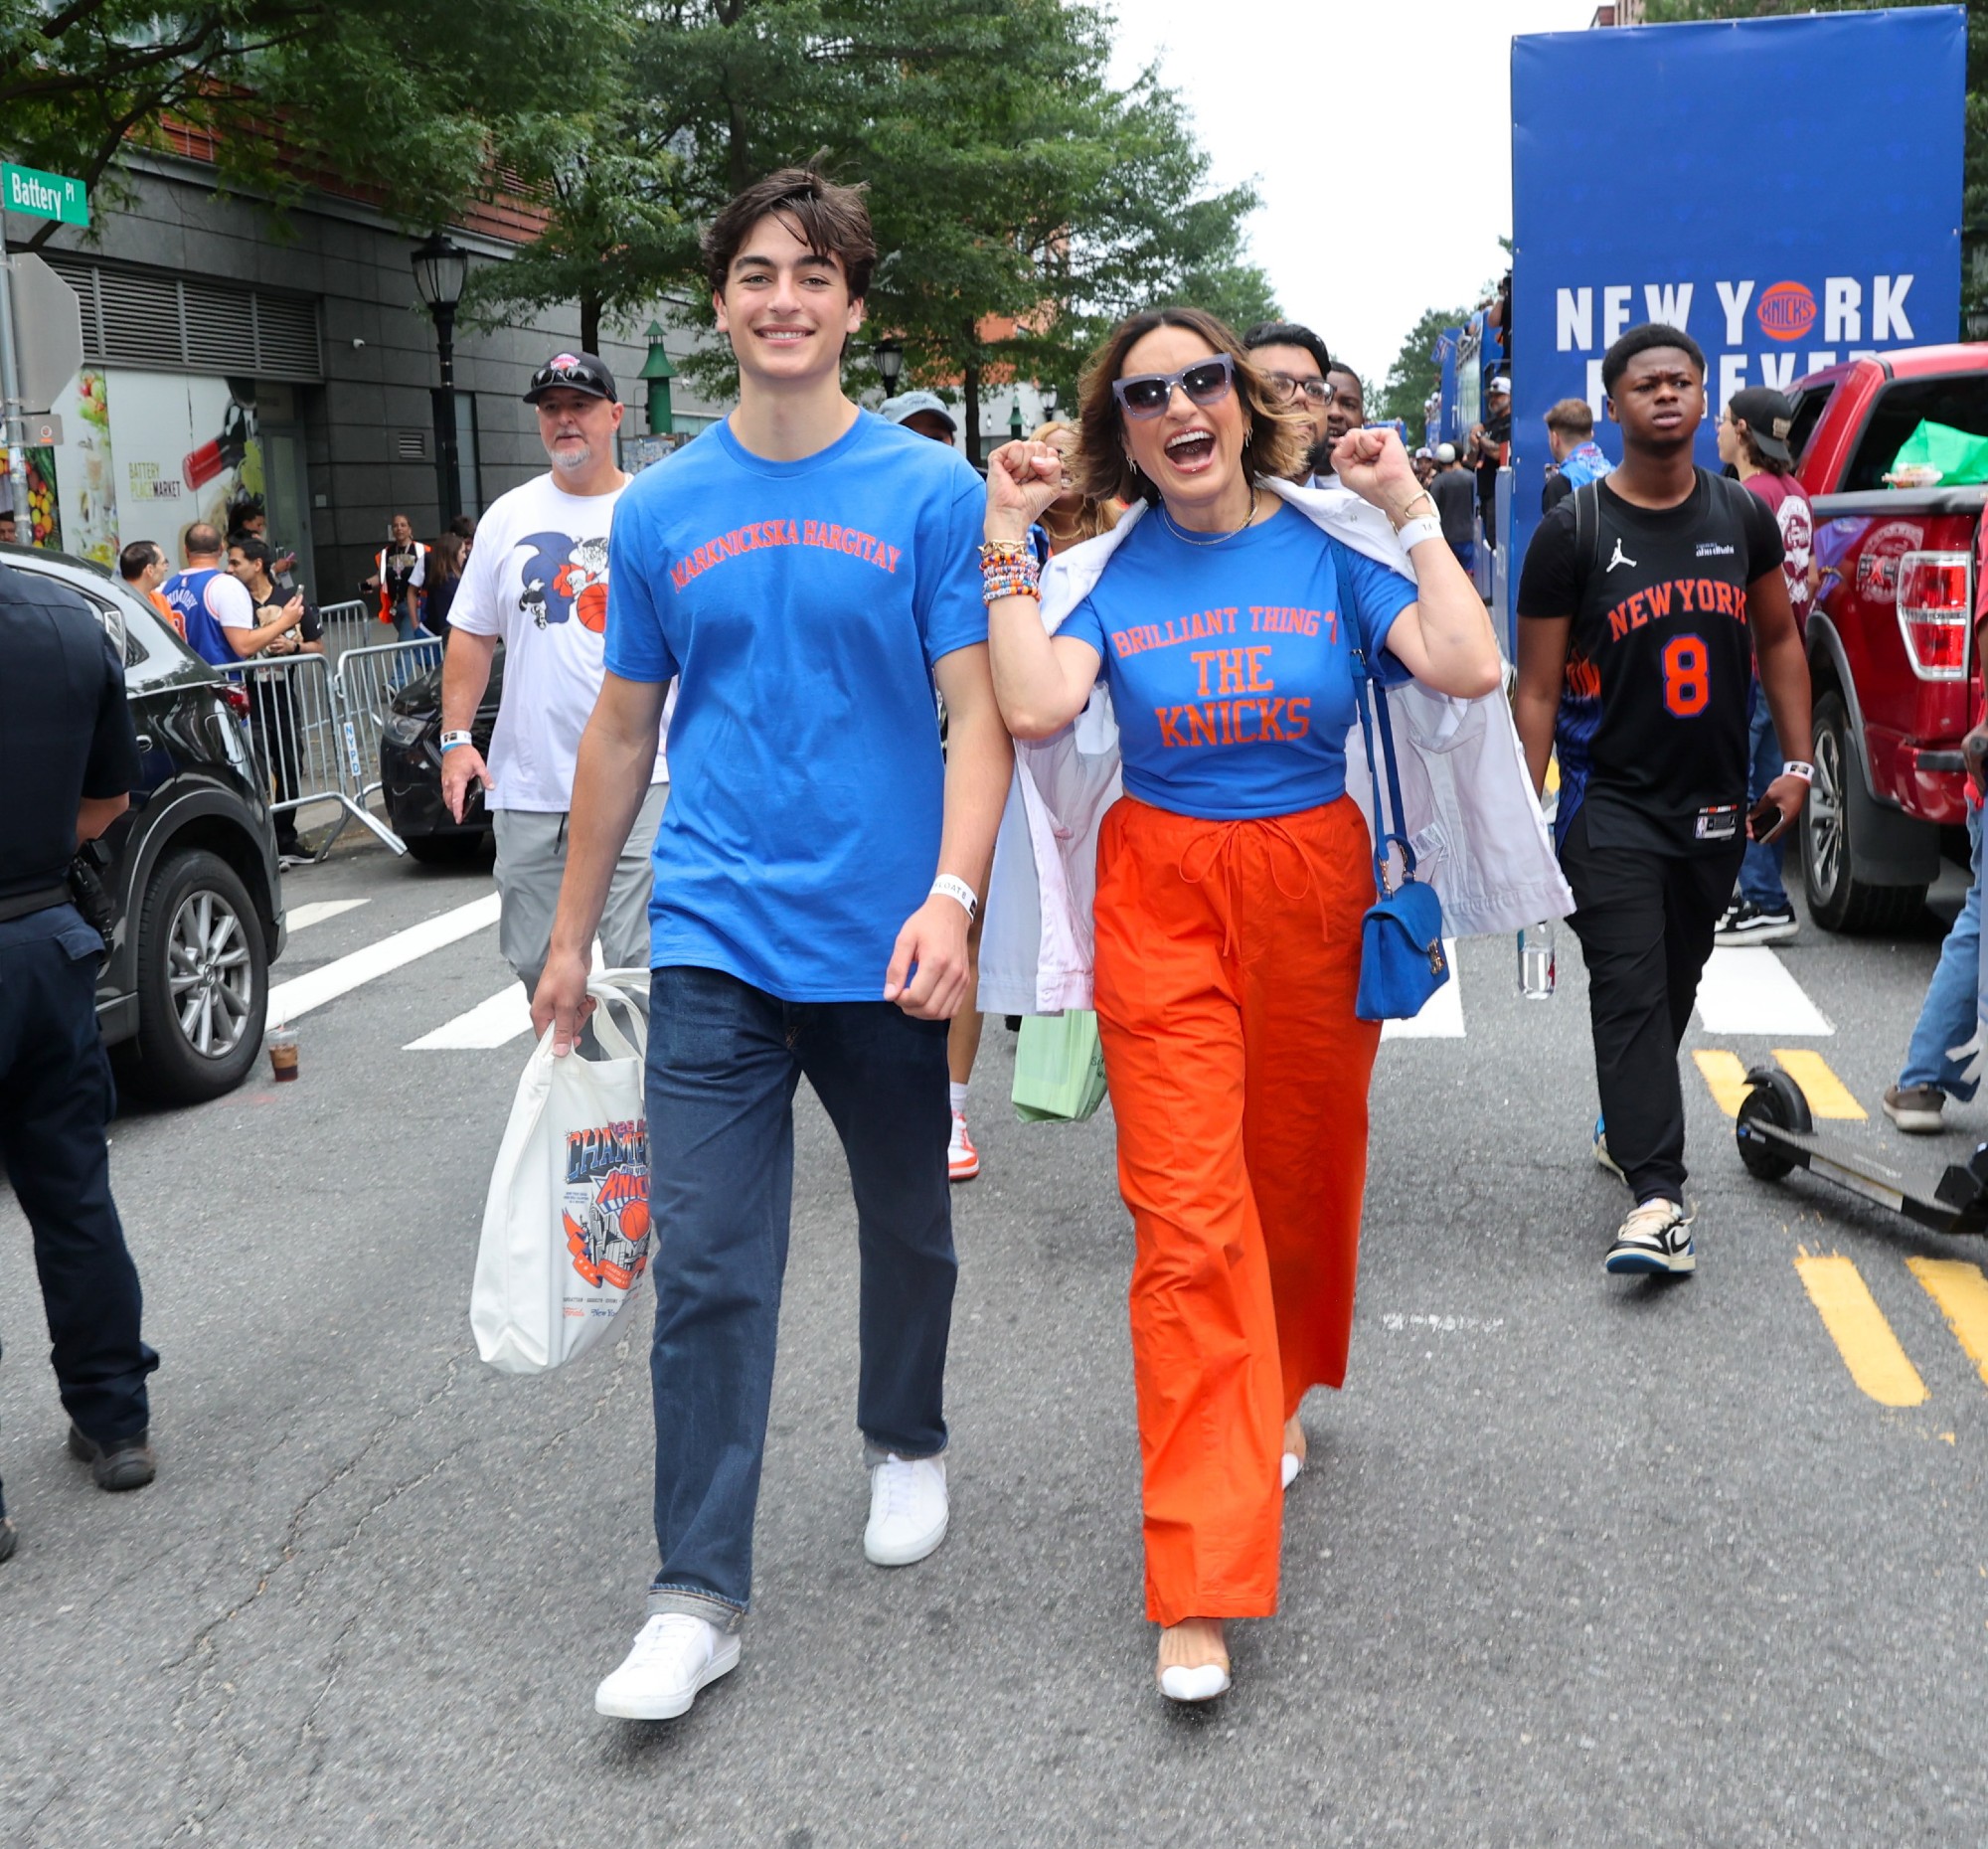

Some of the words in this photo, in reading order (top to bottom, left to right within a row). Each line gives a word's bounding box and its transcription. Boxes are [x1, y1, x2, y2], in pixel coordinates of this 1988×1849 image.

[12, 172, 62, 221] Battery
[66, 182, 75, 202] Pl
[1557, 282, 1694, 351] NEW
[1762, 298, 1812, 326] KNICKS
[128, 462, 160, 479] BATTERY
[670, 518, 799, 593] MARKNICKSKA
[803, 520, 902, 574] HARGITAY
[1111, 607, 1239, 658] BRILLIANT
[1607, 581, 1672, 643] NEW
[1675, 579, 1747, 625] YORK
[1191, 645, 1273, 696] THE
[1661, 632, 1711, 720] 8
[1154, 697, 1311, 748] KNICKS
[345, 725, 360, 773] NYPD
